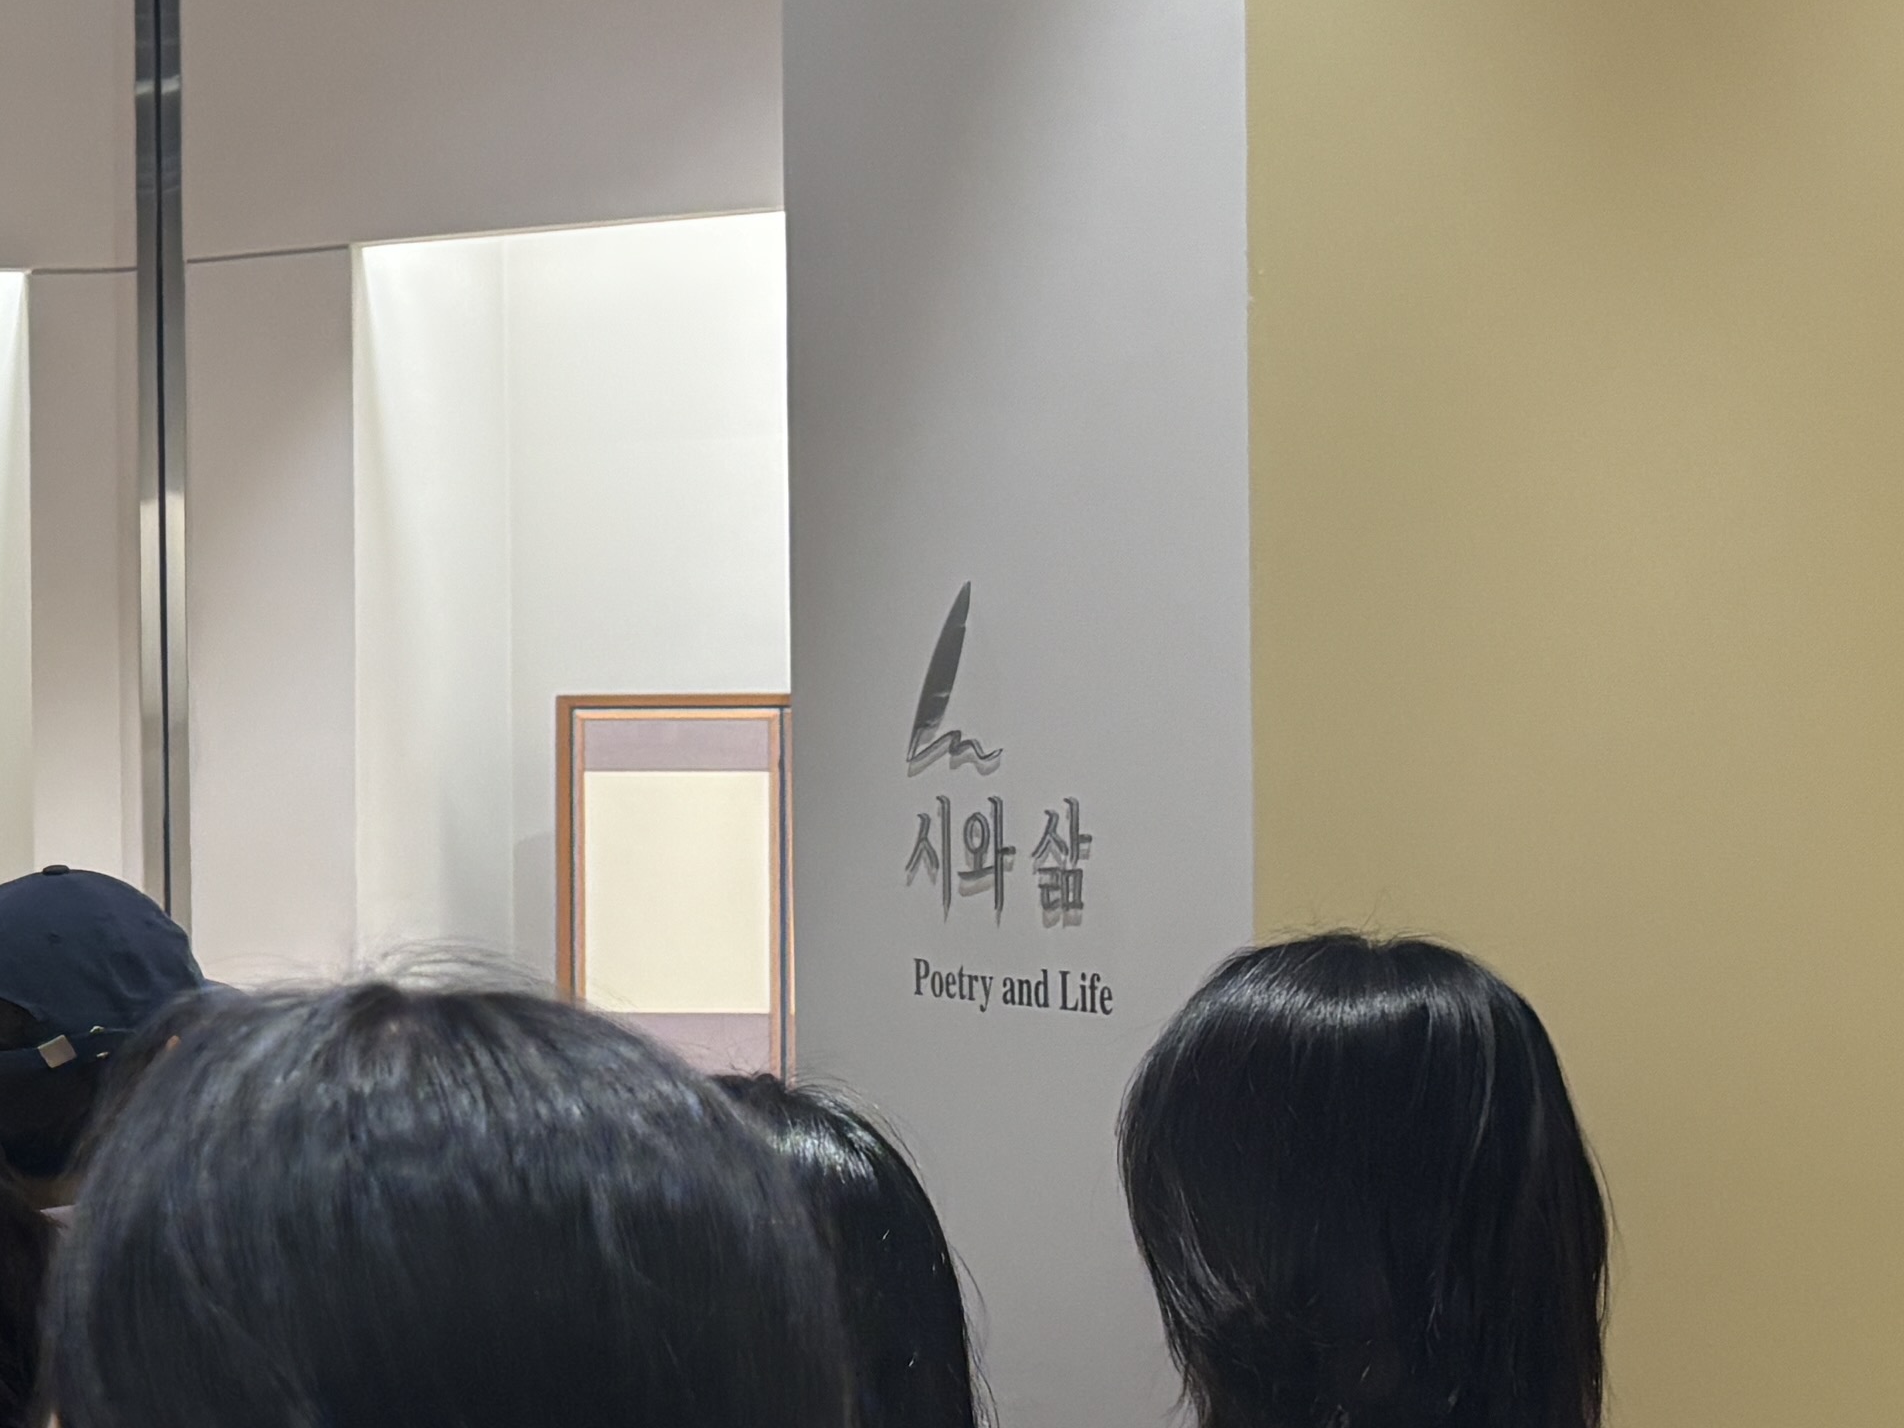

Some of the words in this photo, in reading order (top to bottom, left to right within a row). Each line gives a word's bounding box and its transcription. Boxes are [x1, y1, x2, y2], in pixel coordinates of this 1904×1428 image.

[905, 795, 1017, 917] 시와
[1031, 797, 1093, 915] 삶
[913, 958, 994, 1013] Poetry
[1002, 968, 1050, 1009] and
[1059, 970, 1113, 1016] Life
